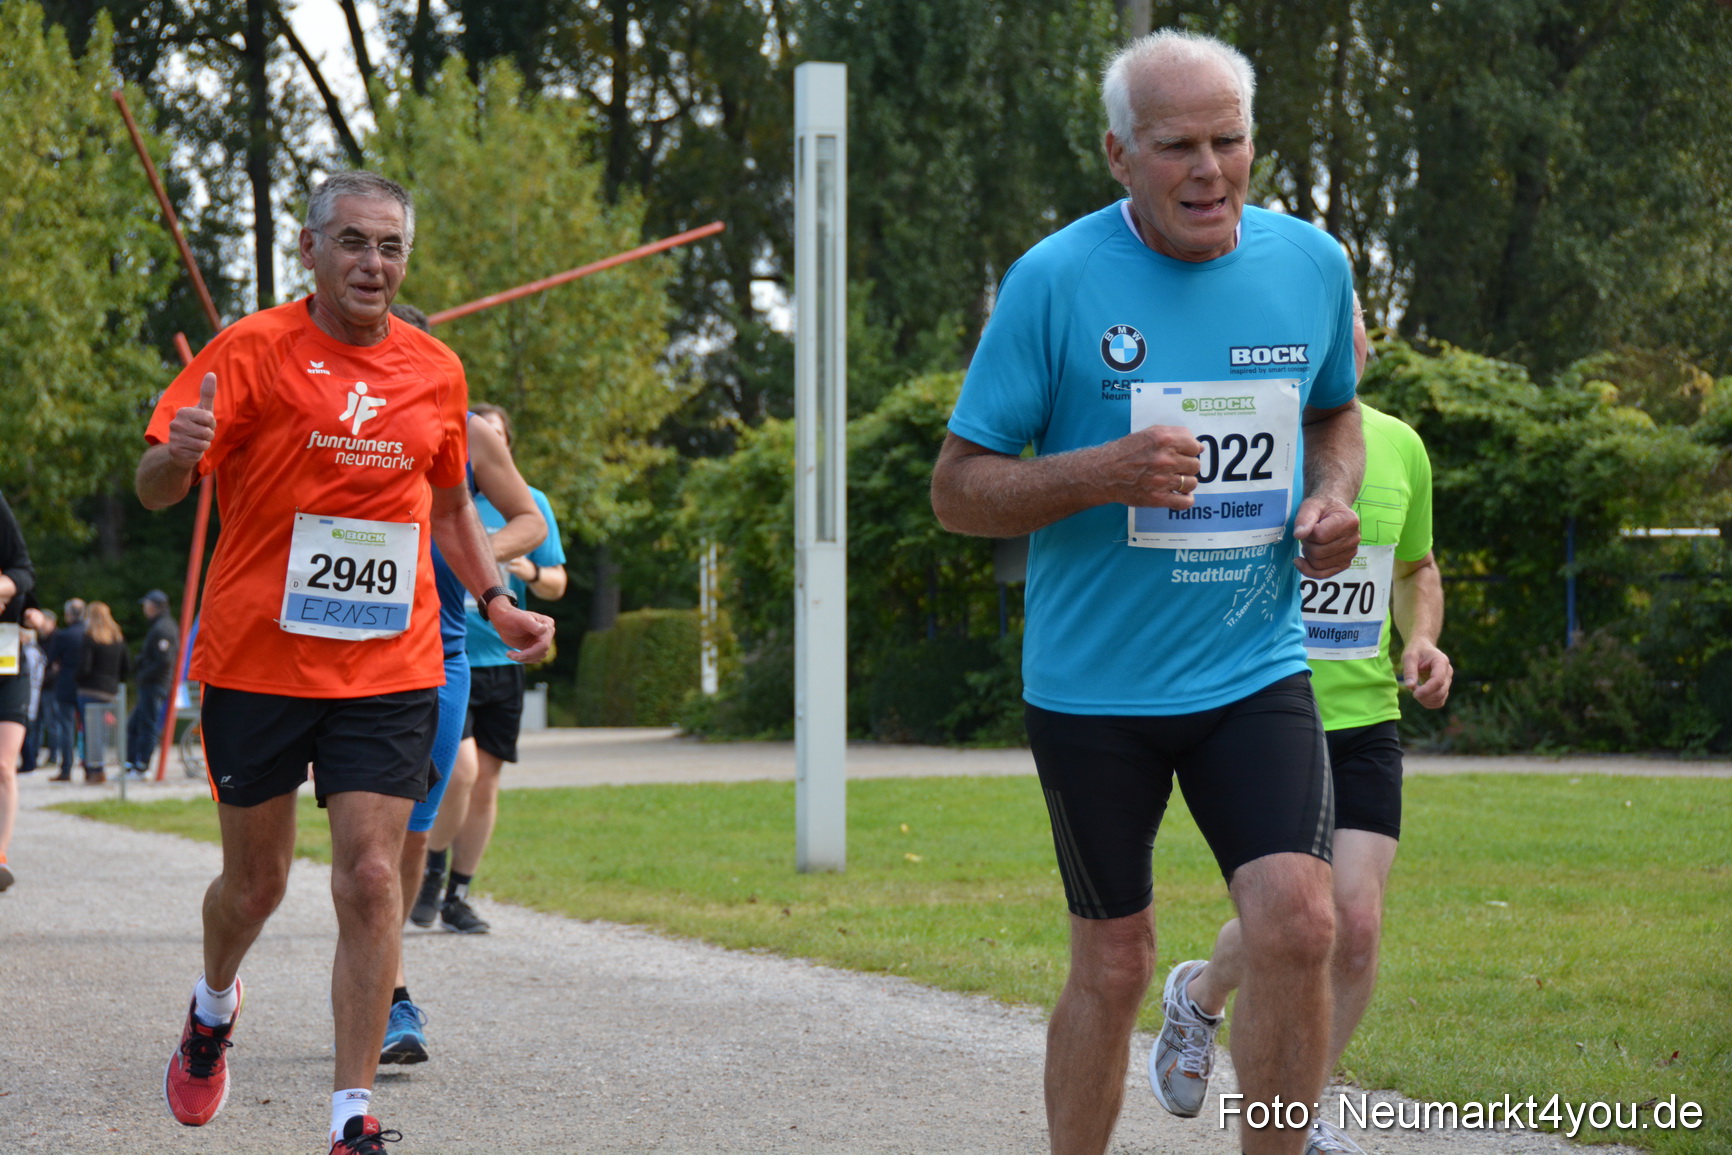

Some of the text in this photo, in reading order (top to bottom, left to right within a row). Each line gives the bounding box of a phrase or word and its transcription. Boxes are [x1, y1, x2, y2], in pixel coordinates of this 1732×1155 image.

[1104, 326, 1142, 342] BMW
[1230, 345, 1309, 366] BOCK
[1230, 367, 1257, 375] inspired
[1102, 391, 1131, 400] Neum
[1199, 397, 1255, 411] BOCK
[306, 431, 403, 454] funrunners
[335, 452, 415, 470] neumarkt
[1195, 432, 1275, 484] 022
[345, 530, 386, 543] BOCK
[1174, 544, 1269, 562] Neumarkter
[307, 553, 397, 595] 2949
[1171, 564, 1253, 583] Stadtlauf
[1300, 579, 1375, 615] 2270
[301, 598, 398, 625] ERNST
[1308, 626, 1360, 643] Wolfgang
